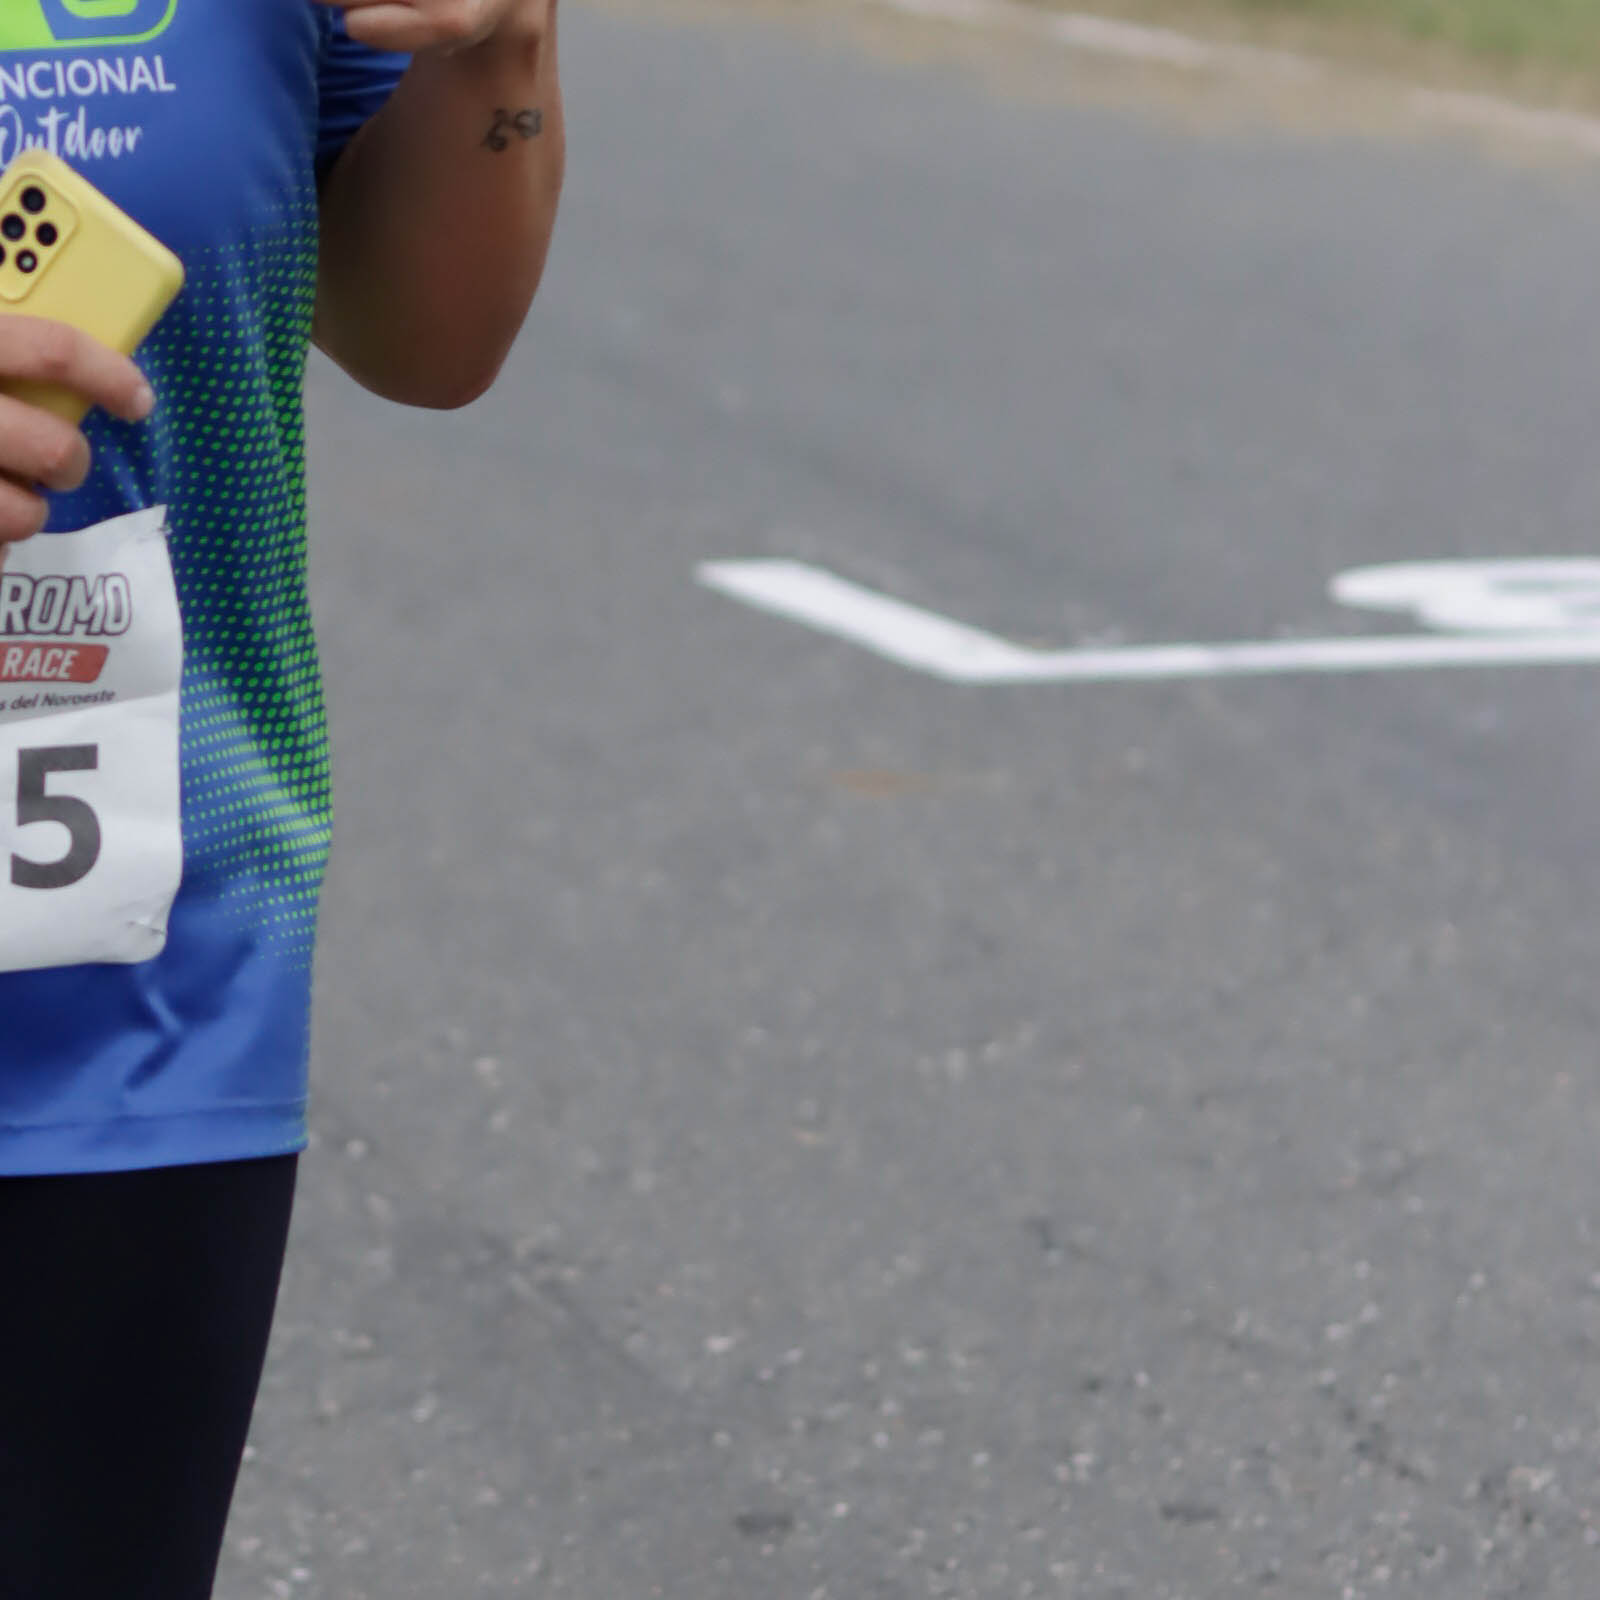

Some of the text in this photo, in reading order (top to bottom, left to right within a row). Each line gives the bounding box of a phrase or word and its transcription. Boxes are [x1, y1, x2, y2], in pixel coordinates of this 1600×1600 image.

[1, 646, 80, 680] RACE
[10, 693, 39, 710] del
[41, 690, 116, 707] Noroeste
